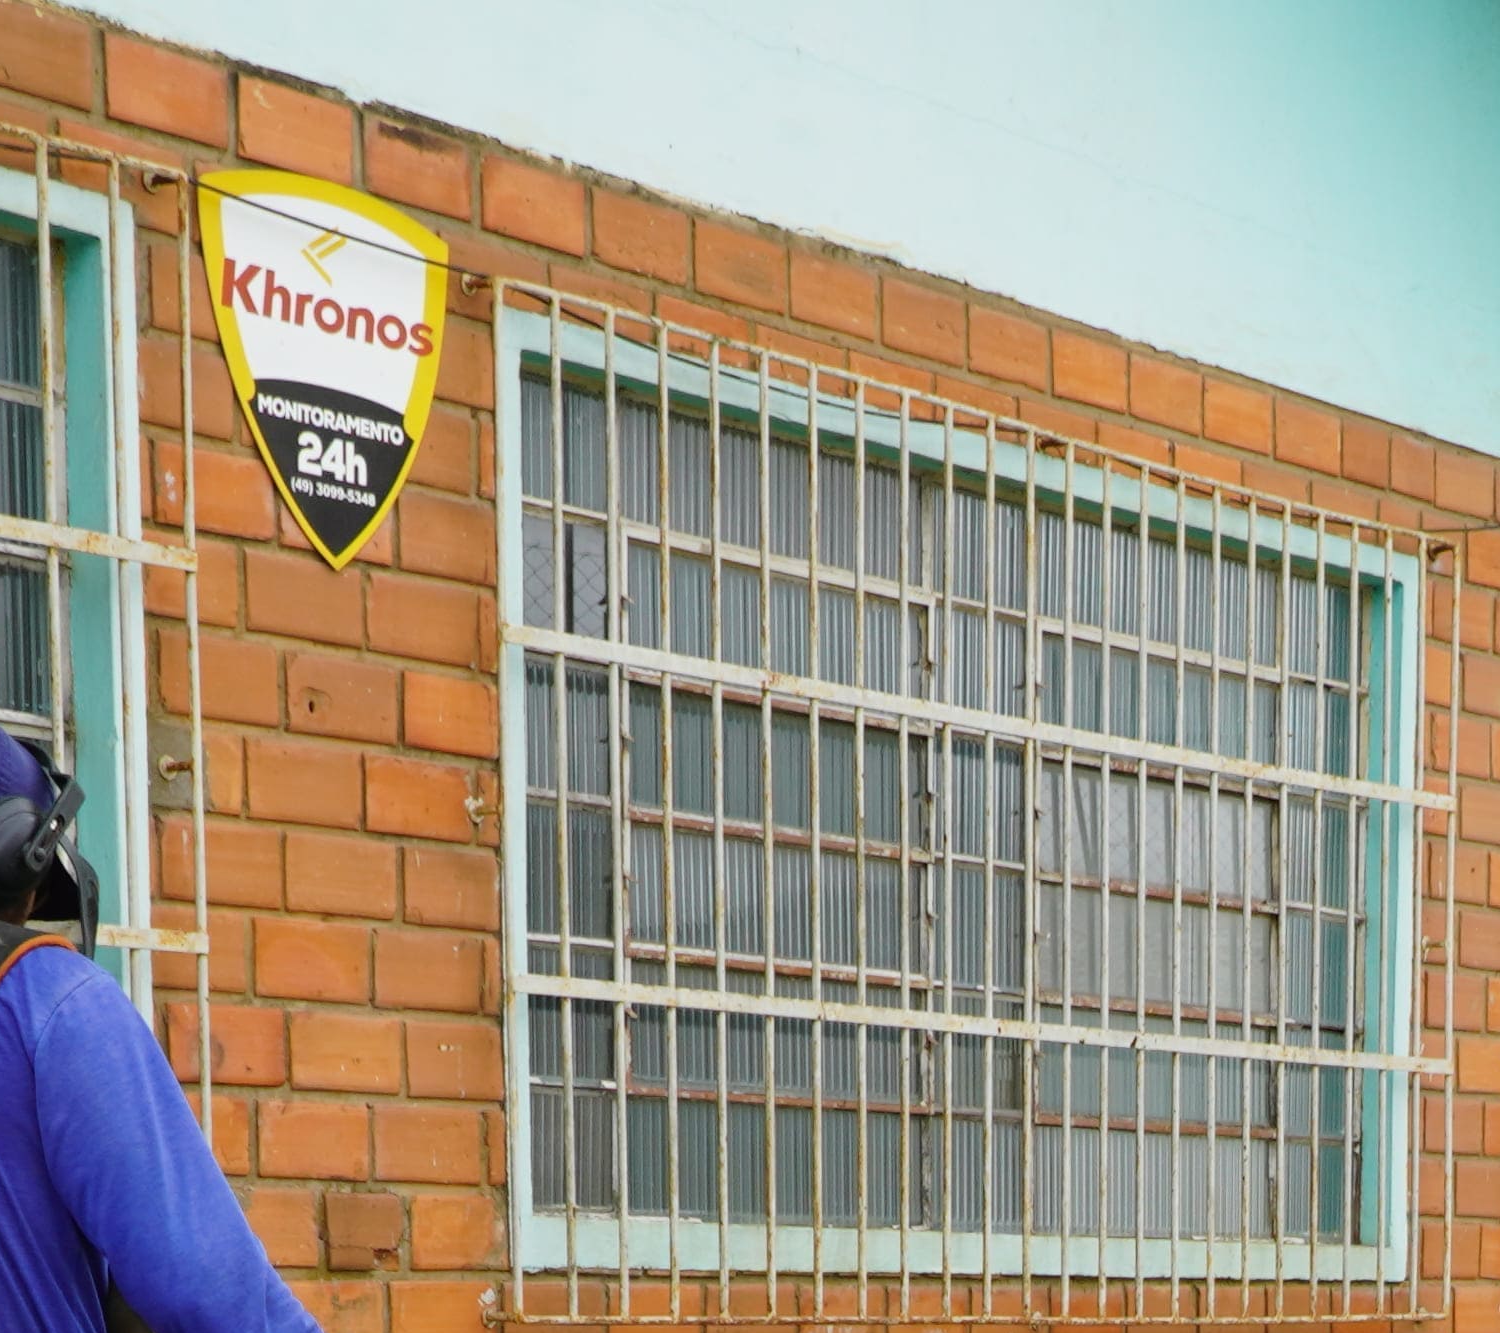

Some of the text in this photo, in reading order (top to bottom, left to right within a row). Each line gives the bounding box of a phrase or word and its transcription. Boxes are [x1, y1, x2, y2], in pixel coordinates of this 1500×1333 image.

[221, 258, 434, 357] Khronos
[257, 392, 405, 446] MONITORAMENTO
[297, 430, 368, 487] 24h
[290, 475, 376, 508] (49) 3099-5348
